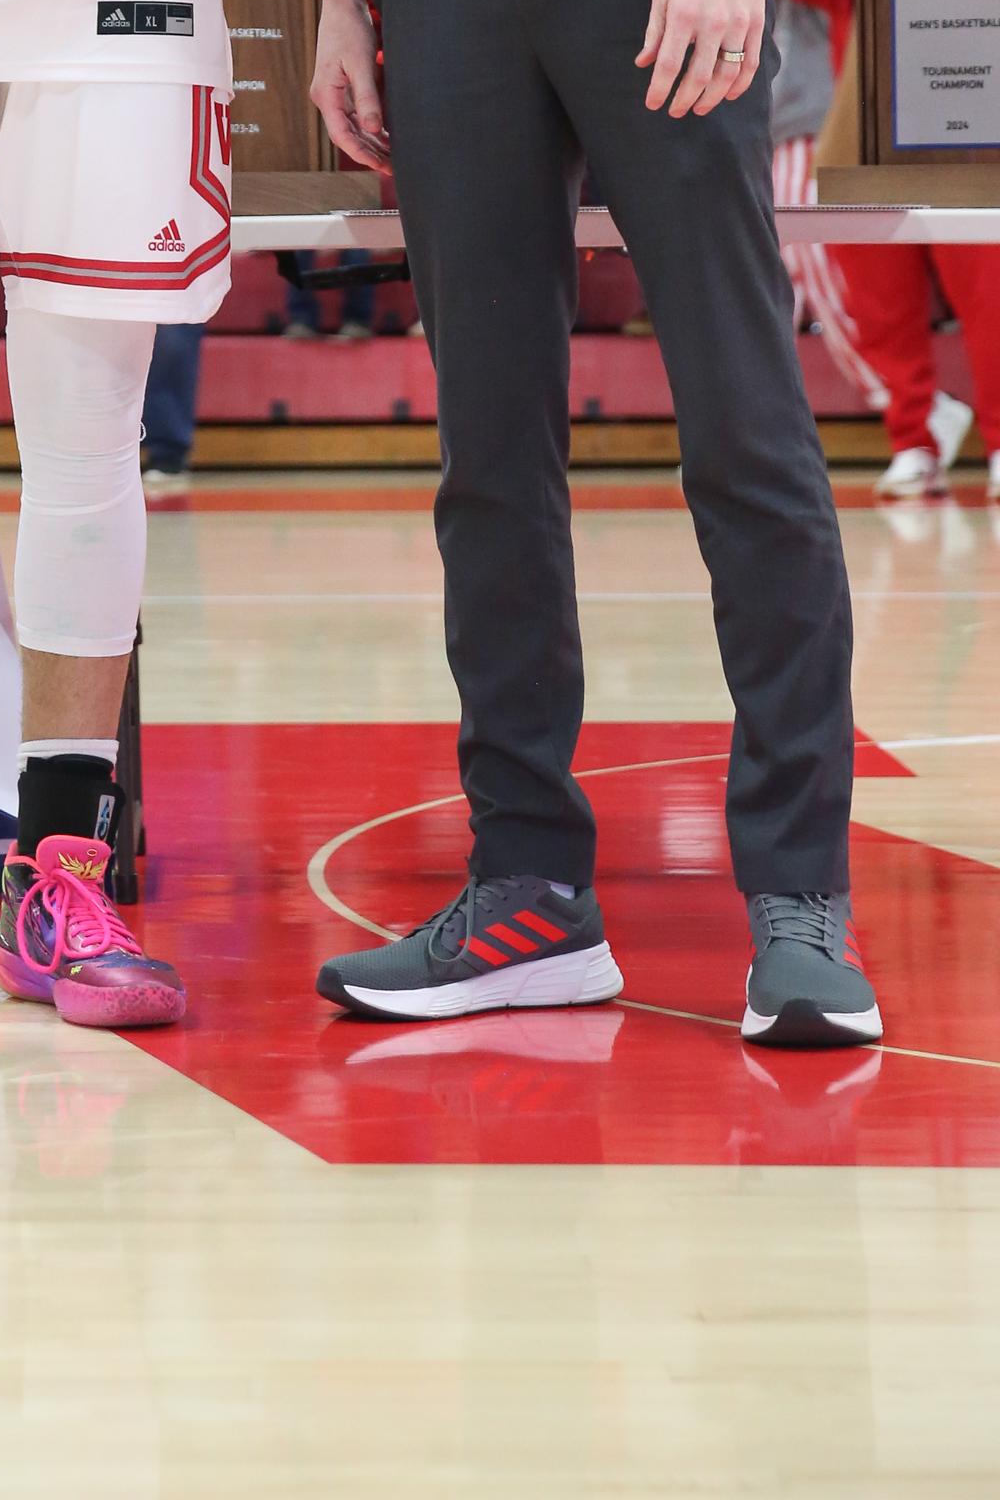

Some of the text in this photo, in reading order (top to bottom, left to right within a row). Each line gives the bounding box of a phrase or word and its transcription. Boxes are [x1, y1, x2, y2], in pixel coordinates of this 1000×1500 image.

[101, 15, 158, 28] adidas XL
[909, 19, 939, 29] MEN'S
[923, 65, 992, 76] TOURNAMENT
[930, 79, 984, 90] CHAMPION
[946, 120, 969, 131] 2024
[147, 238, 186, 253] adidas
